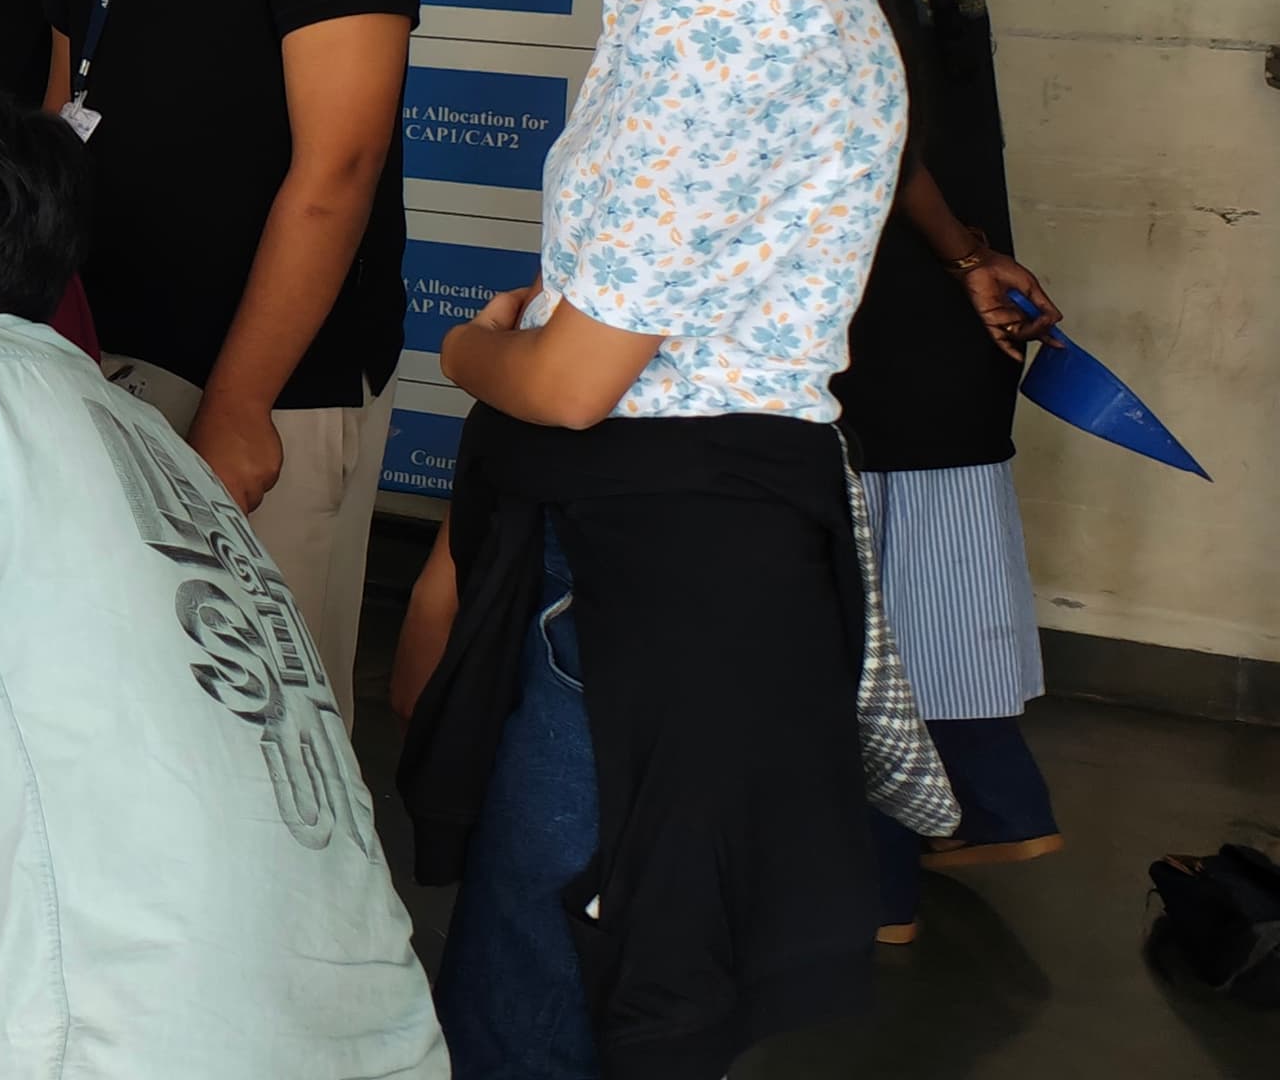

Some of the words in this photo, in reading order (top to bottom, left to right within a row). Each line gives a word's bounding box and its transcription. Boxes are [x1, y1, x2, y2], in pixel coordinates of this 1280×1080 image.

[424, 106, 516, 129] Allocation
[521, 114, 549, 132] for
[406, 124, 520, 150] CAP1/CAP2
